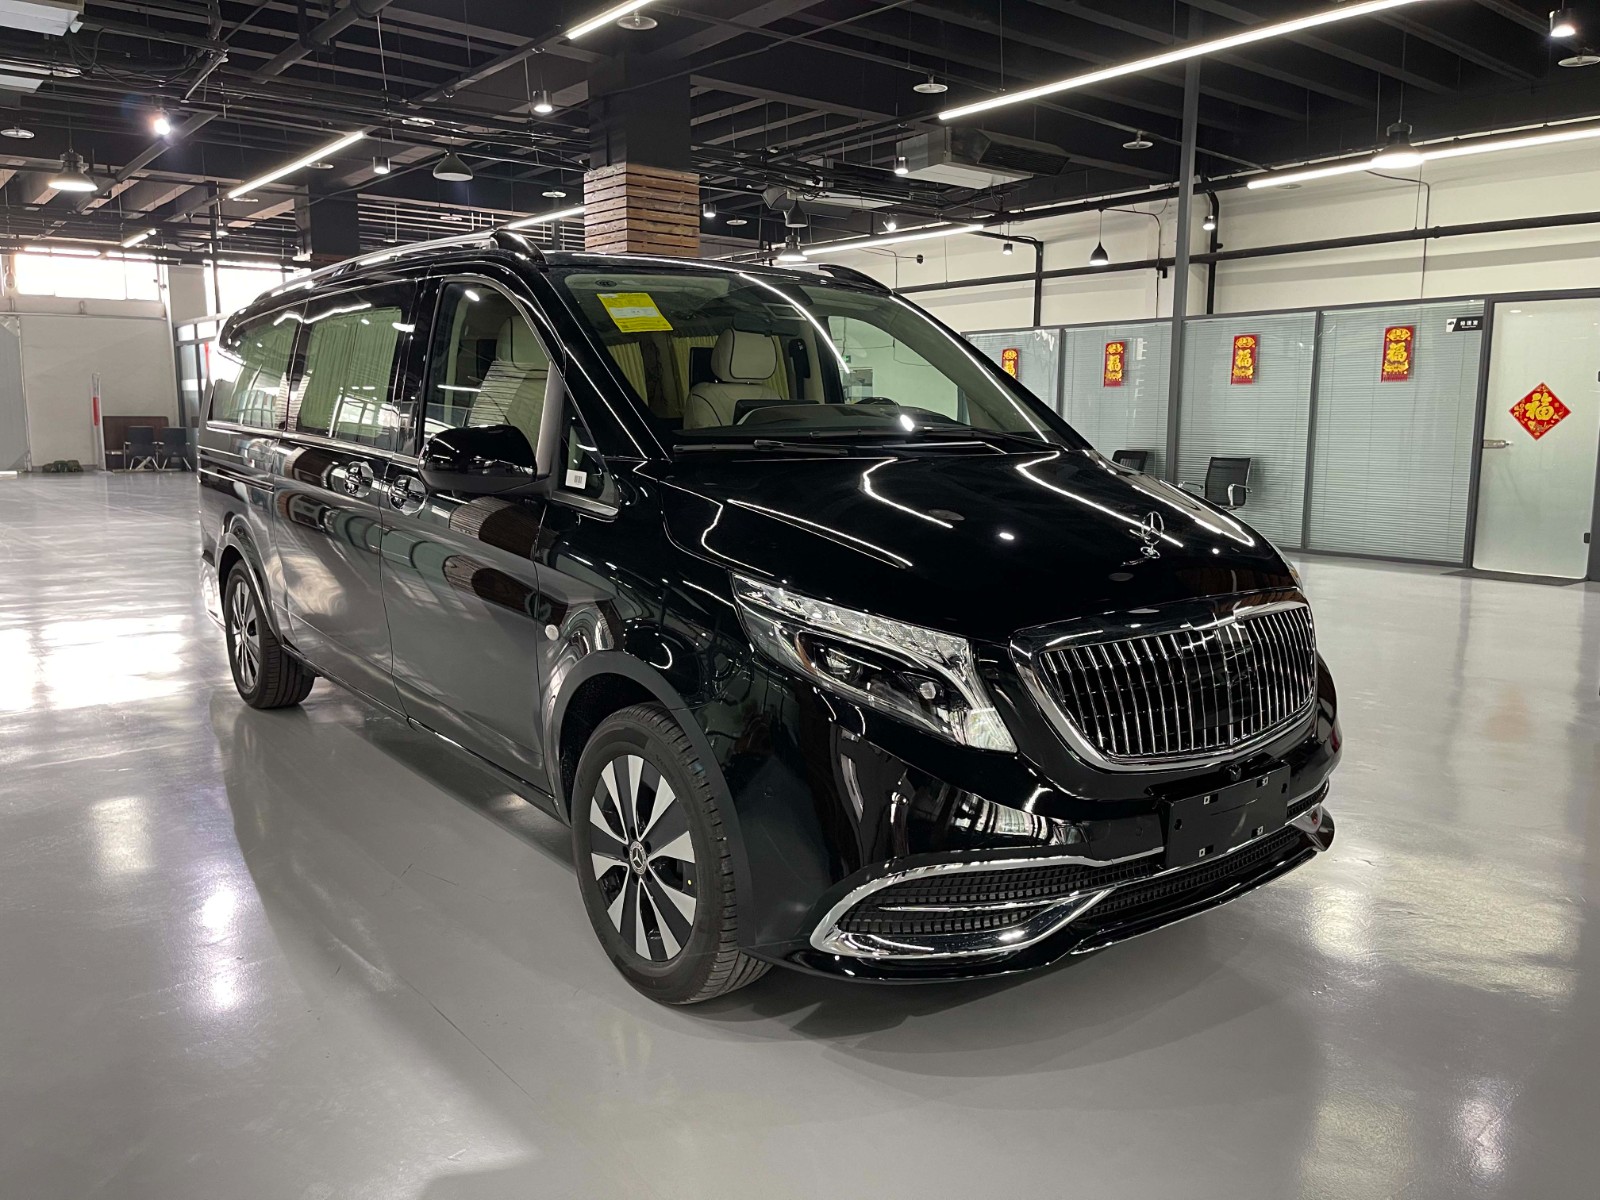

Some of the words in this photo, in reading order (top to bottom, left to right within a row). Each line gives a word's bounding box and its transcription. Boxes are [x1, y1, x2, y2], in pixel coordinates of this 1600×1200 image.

[1235, 349, 1252, 367] 福
[1386, 341, 1408, 362] 福
[1107, 354, 1121, 371] 福
[1524, 392, 1555, 421] 福
